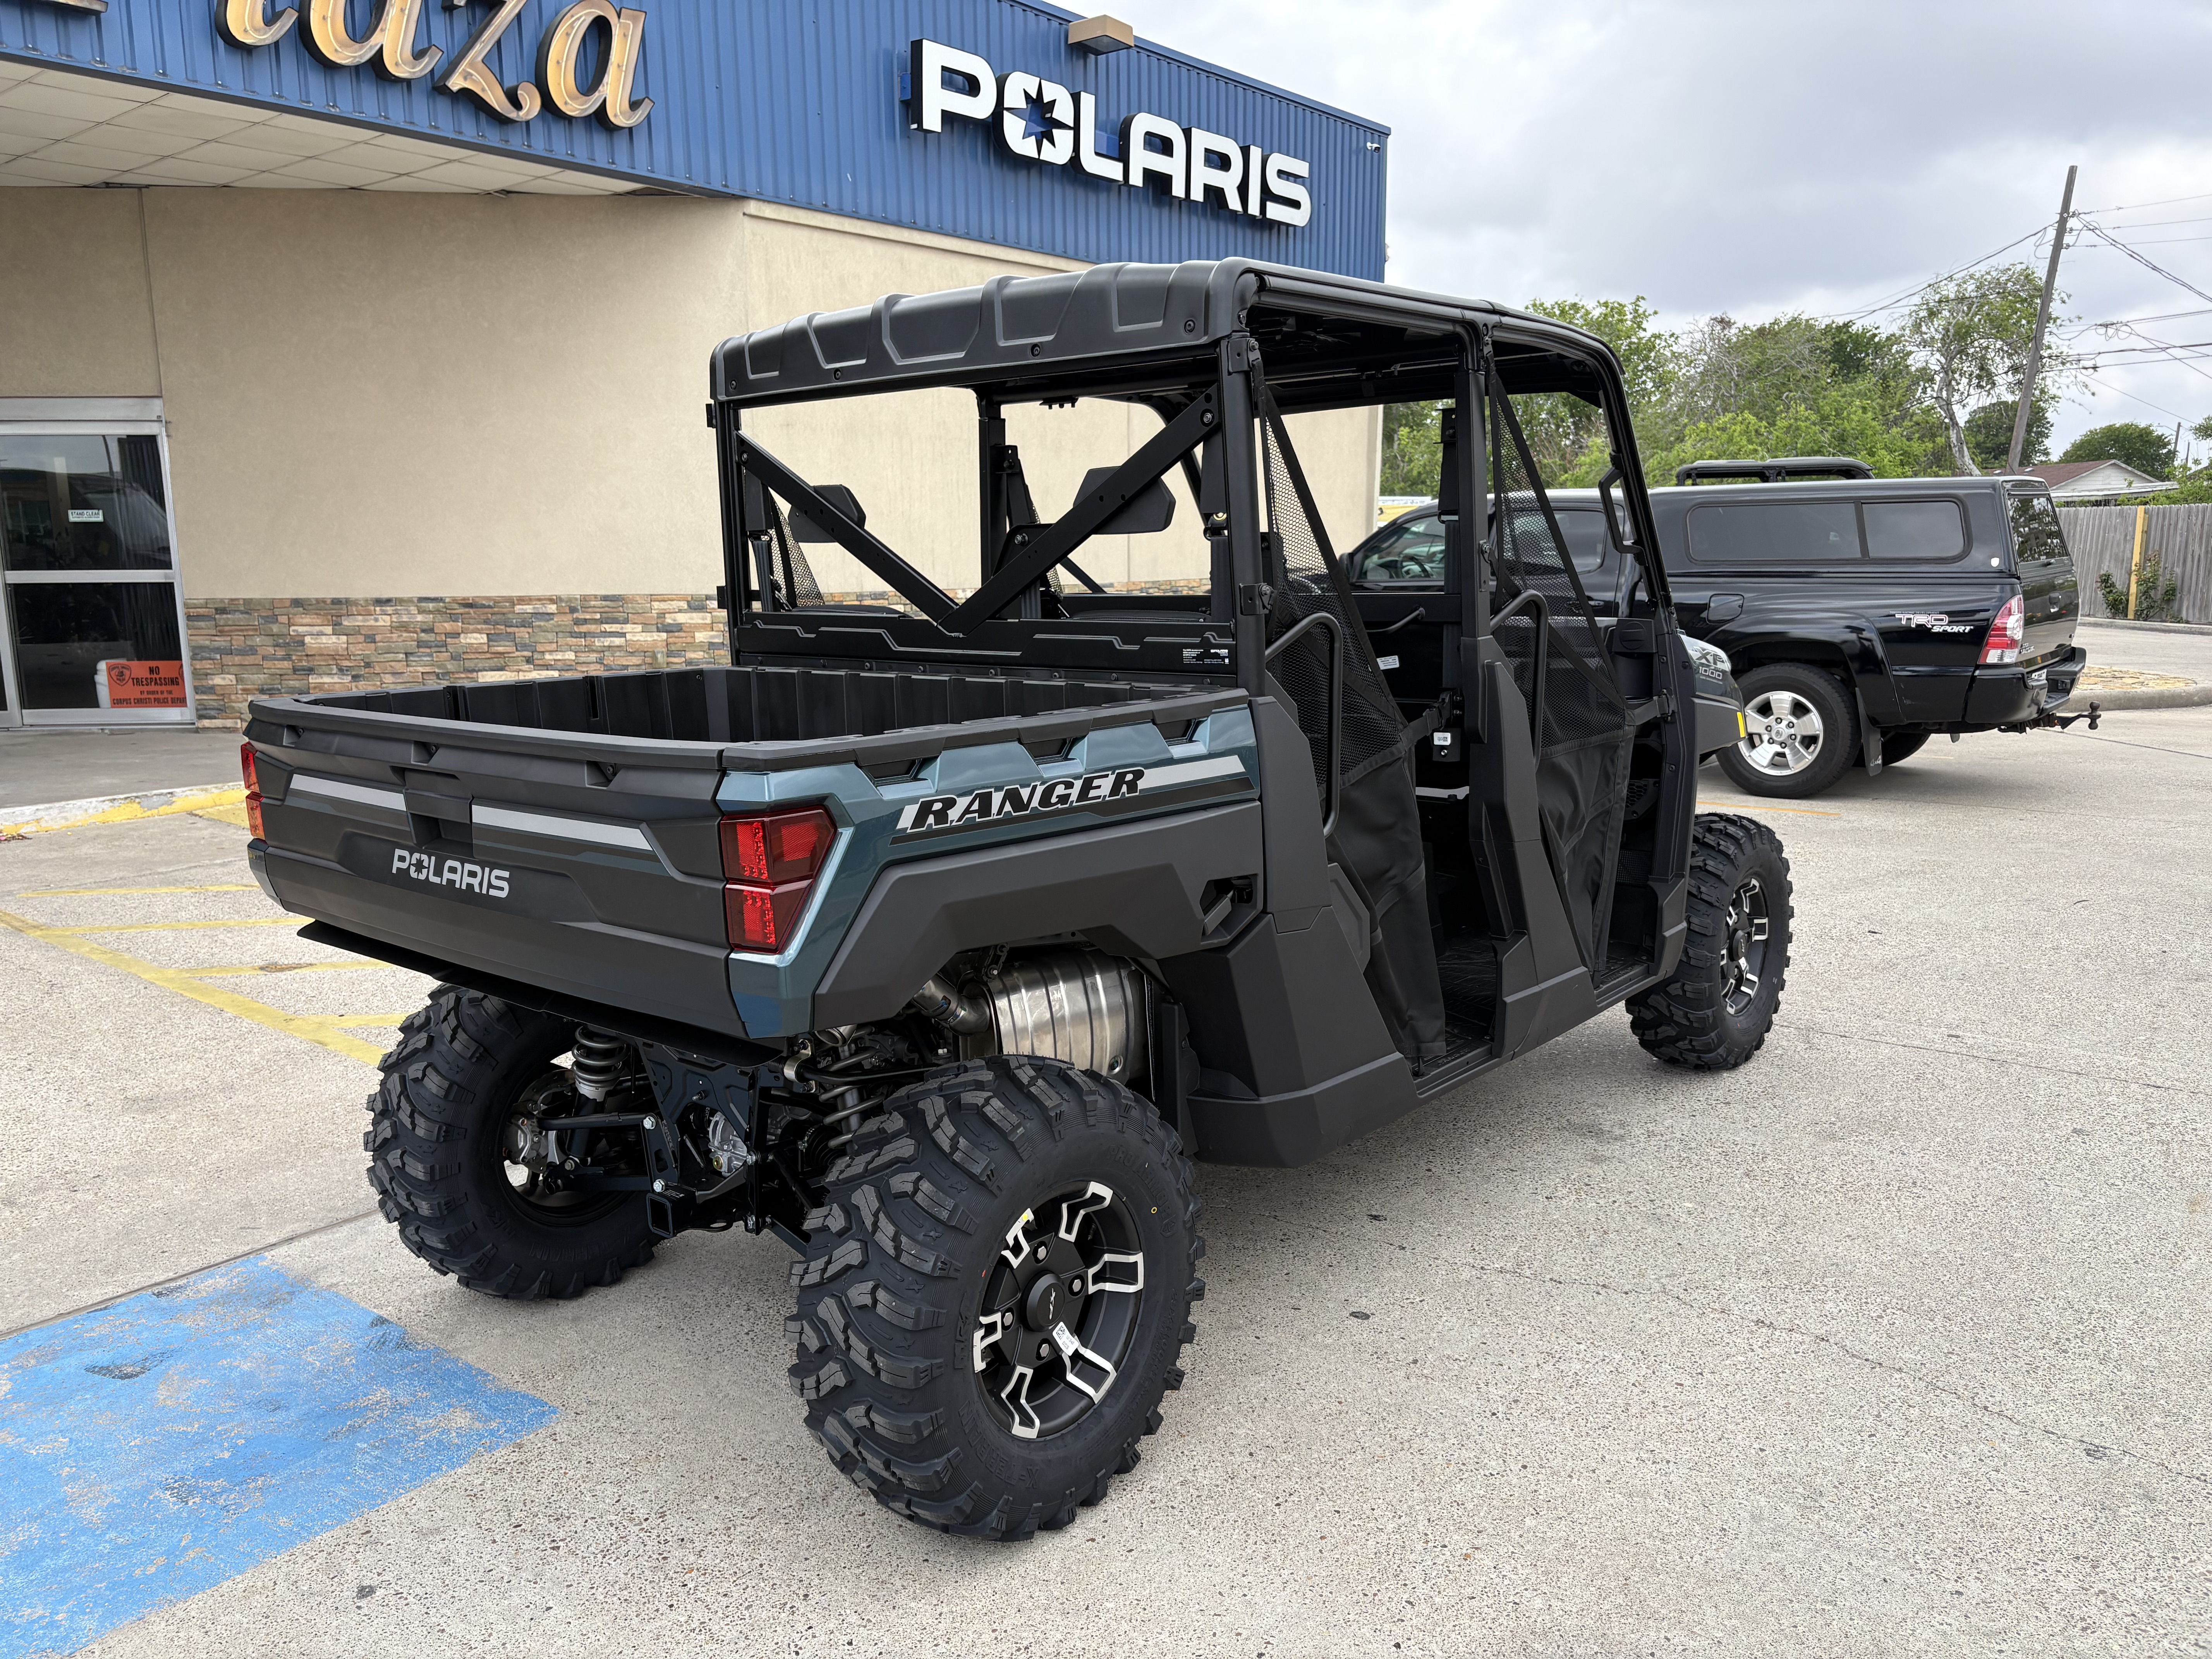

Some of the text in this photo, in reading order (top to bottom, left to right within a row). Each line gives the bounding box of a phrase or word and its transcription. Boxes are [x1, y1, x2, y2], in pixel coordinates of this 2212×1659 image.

[911, 38, 1312, 227] POLARIS
[1895, 614, 1948, 628] TRD
[1694, 646, 1725, 666] XP
[149, 666, 160, 675] NO
[1699, 666, 1722, 679] 1000
[131, 677, 180, 687] TRESPASSING
[907, 767, 1146, 833] RANGER
[392, 848, 510, 898] POLARIS
[1107, 1144, 1137, 1167] PRO
[958, 1400, 1040, 1489] X-TERRAIN
